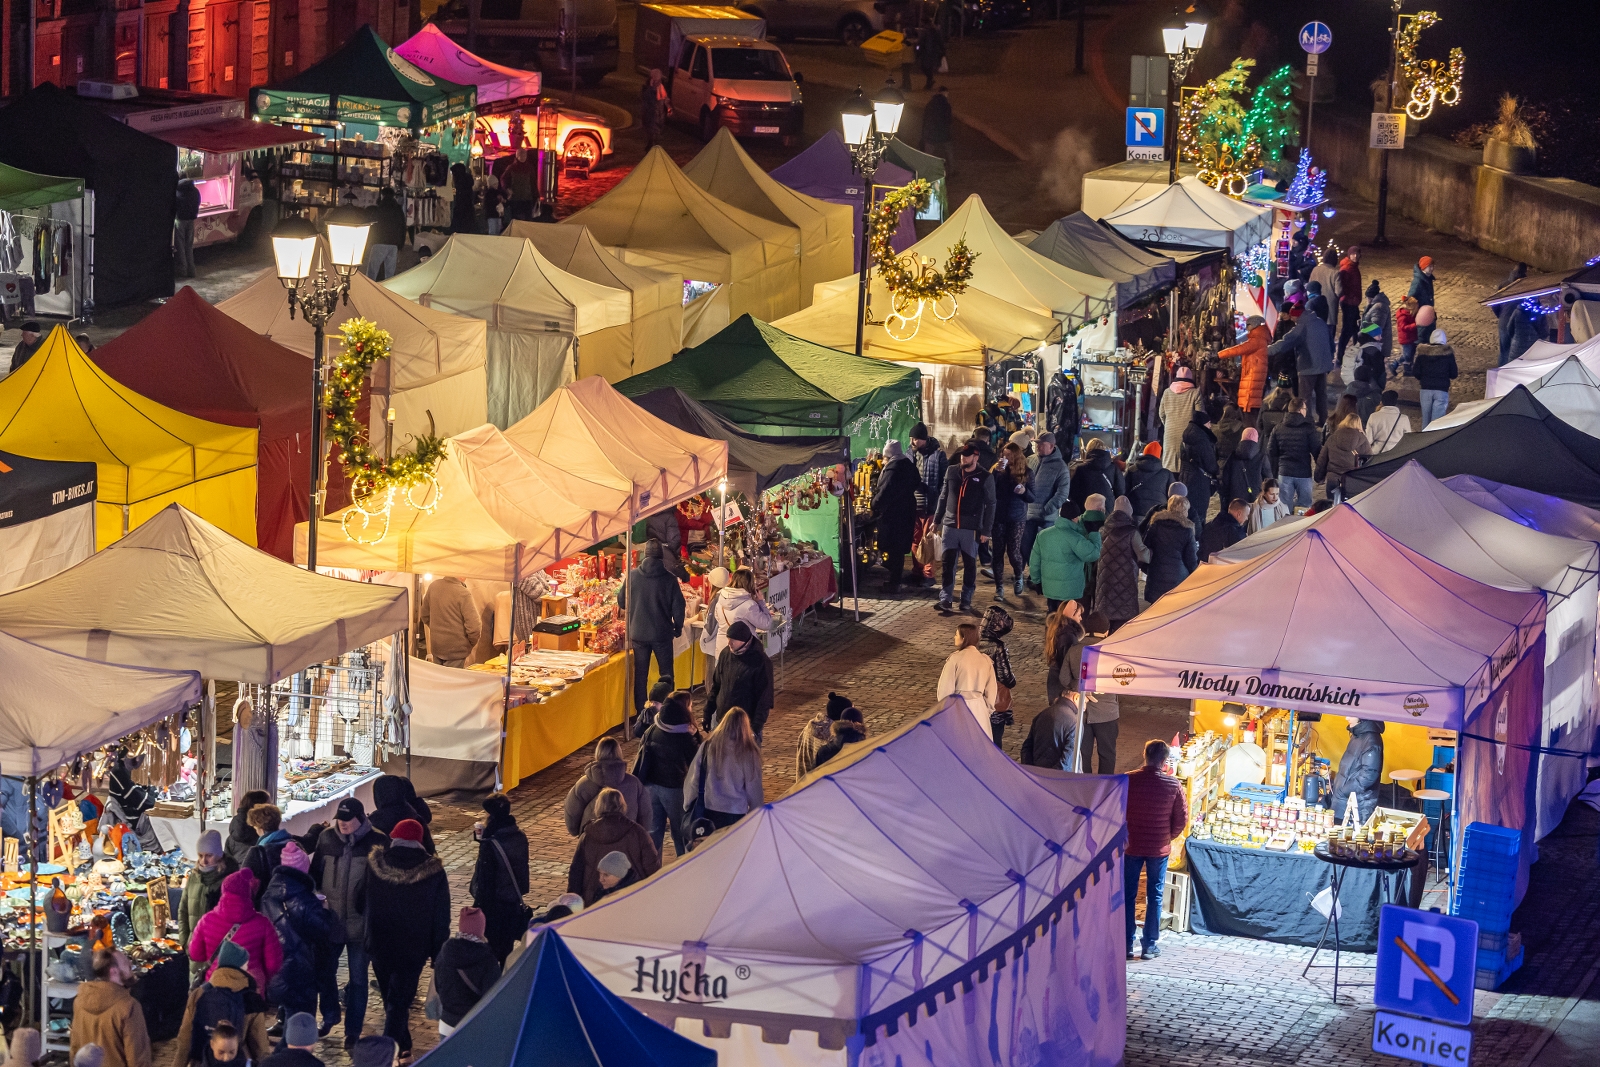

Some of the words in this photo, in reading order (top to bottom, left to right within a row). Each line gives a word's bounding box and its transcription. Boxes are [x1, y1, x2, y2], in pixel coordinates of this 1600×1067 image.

[286, 96, 331, 108] FUNDACJA
[297, 107, 321, 115] POMOC
[150, 113, 163, 122] FRESH
[164, 111, 178, 121] FRUITS
[183, 108, 199, 118] BELGIAN
[1128, 150, 1163, 160] Koniec
[52, 480, 94, 506] KTM-BIKES.AT
[1177, 669, 1241, 697] Miody
[1245, 675, 1361, 707] Domańskich
[630, 955, 728, 1002] Hyćka
[1377, 1020, 1467, 1062] Koniec
